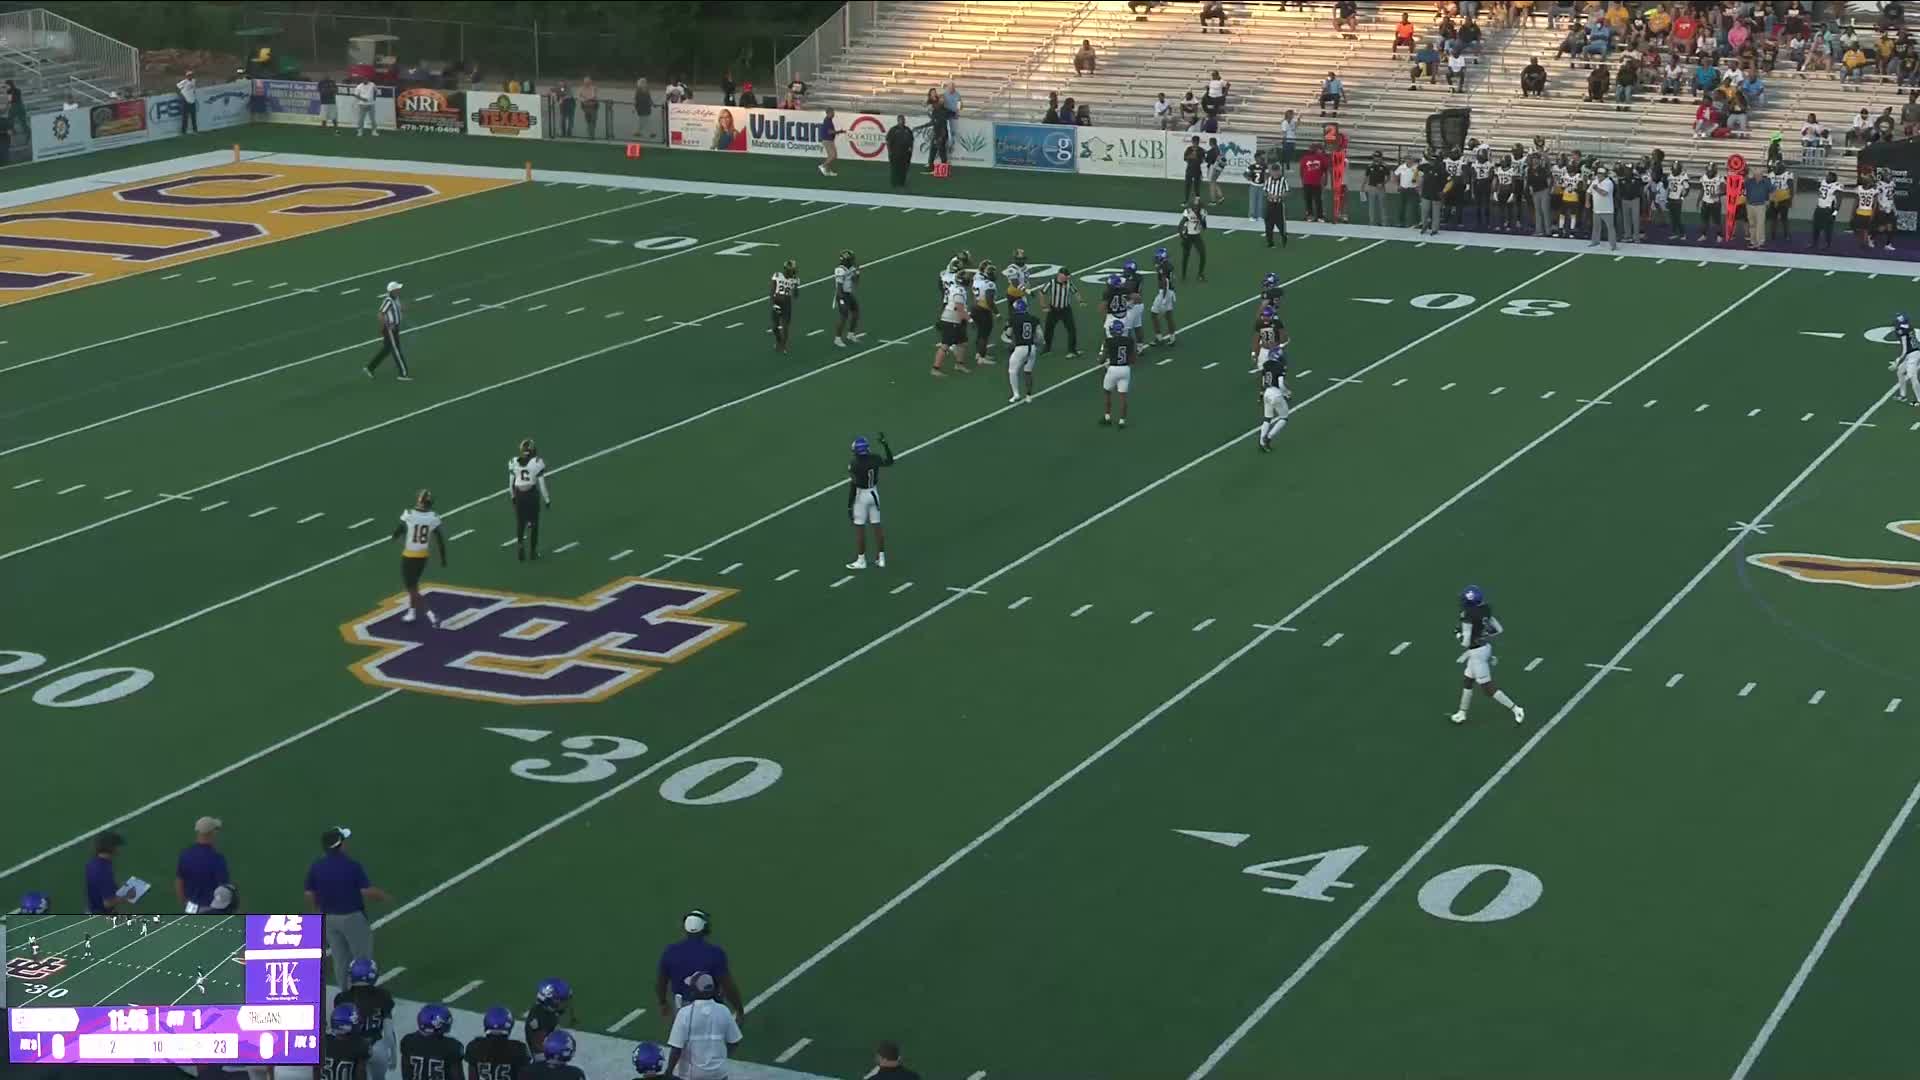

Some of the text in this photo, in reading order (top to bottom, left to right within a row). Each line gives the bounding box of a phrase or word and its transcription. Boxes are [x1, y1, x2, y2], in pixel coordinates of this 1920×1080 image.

[405, 96, 440, 112] NRI
[749, 113, 824, 142] Vulcan
[752, 140, 824, 153] Materials Company
[1118, 137, 1164, 160] MSB
[1860, 196, 1871, 207] 36
[1021, 321, 1034, 340] 8
[1116, 345, 1128, 366] 5
[413, 523, 431, 545] 18
